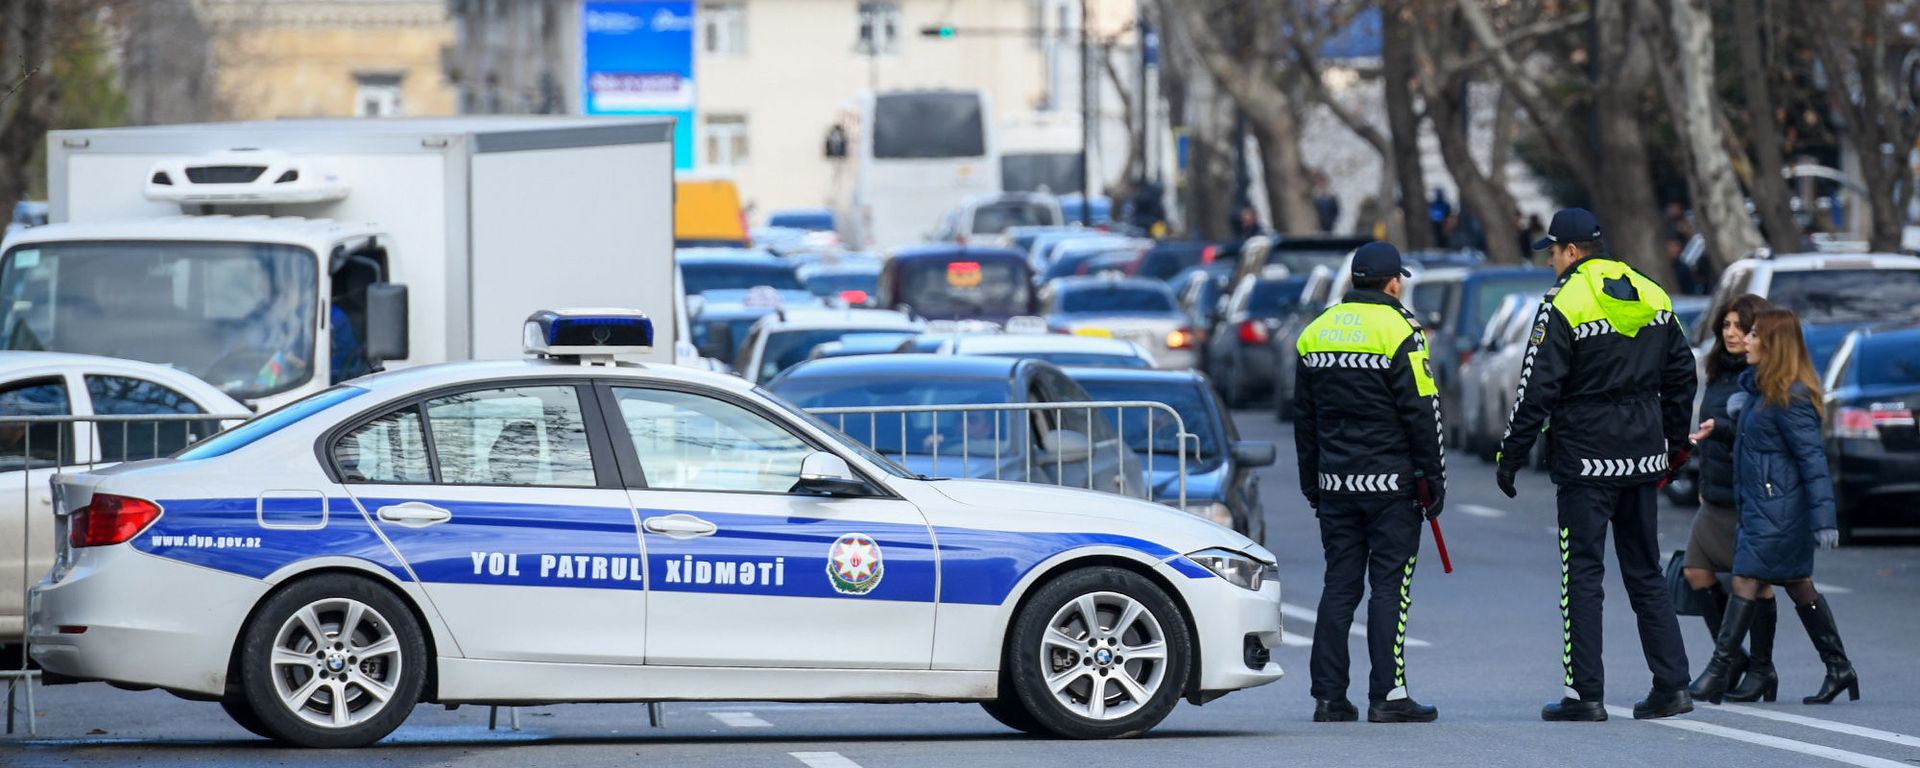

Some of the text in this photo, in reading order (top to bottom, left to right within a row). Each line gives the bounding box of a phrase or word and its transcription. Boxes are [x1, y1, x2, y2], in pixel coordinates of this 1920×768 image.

[1333, 313, 1362, 326] YOL
[151, 534, 261, 548] www.dyp.gov.az
[471, 551, 784, 586] YOL PATRUL XİDMƏTİ
